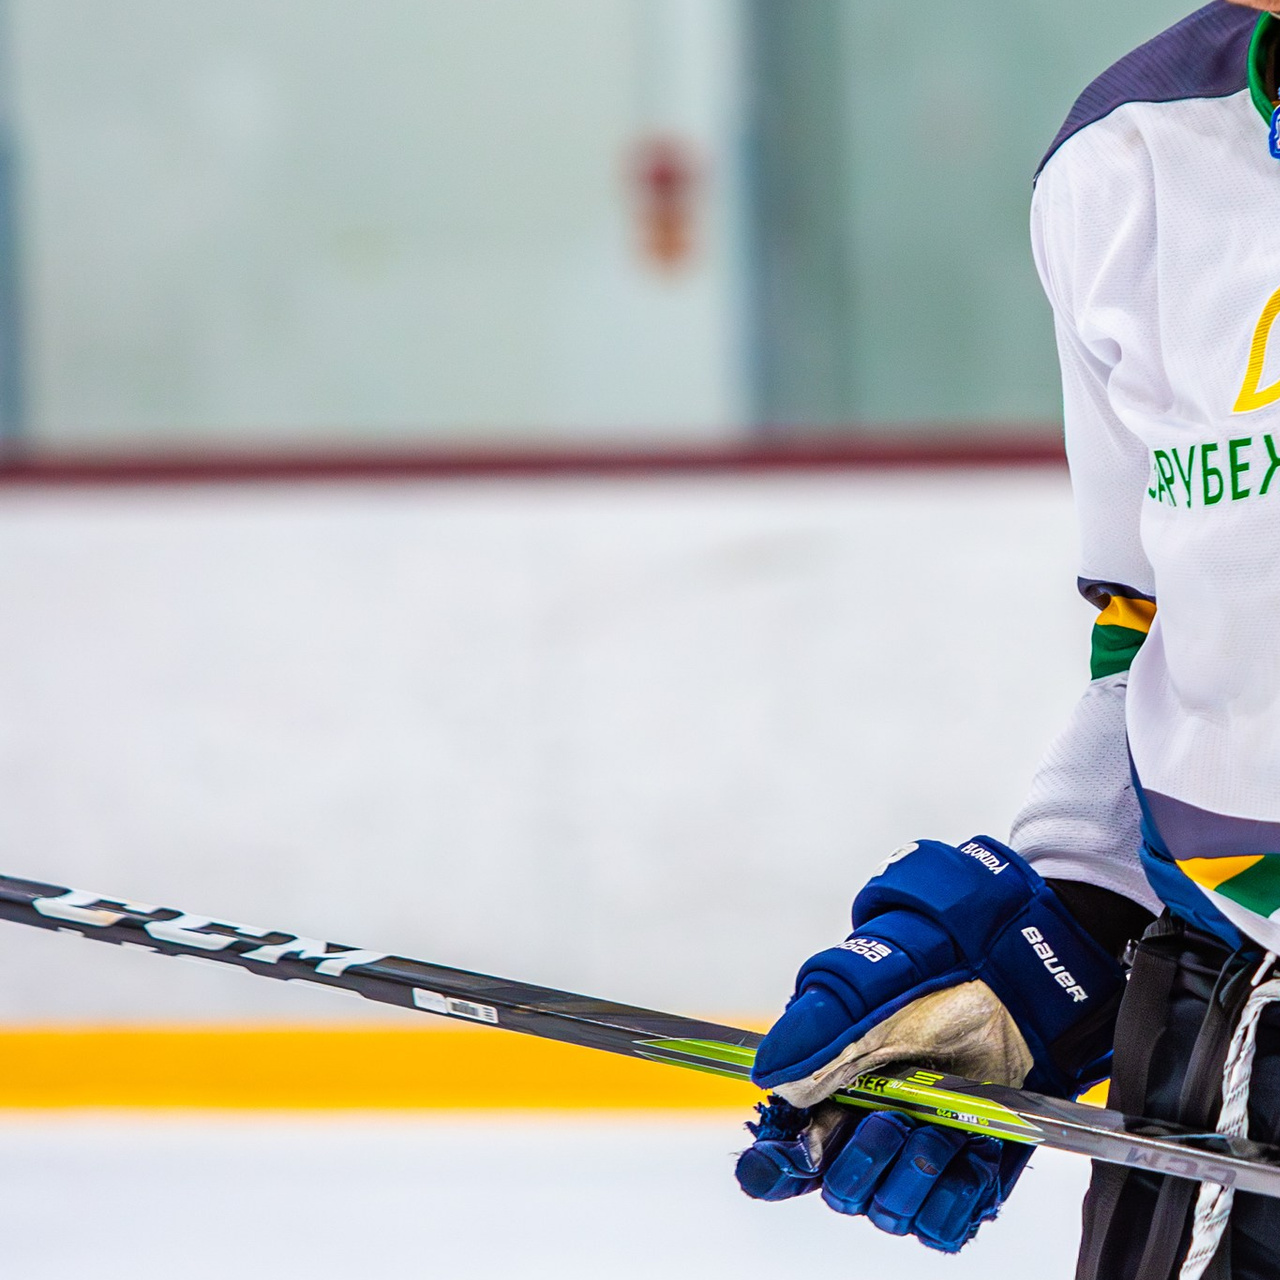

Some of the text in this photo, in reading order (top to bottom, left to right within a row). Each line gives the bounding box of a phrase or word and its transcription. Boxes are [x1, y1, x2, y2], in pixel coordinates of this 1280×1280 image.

[961, 842, 1010, 875] FLORIDA
[32, 888, 397, 977] CCM
[1021, 926, 1088, 1003] BAUER
